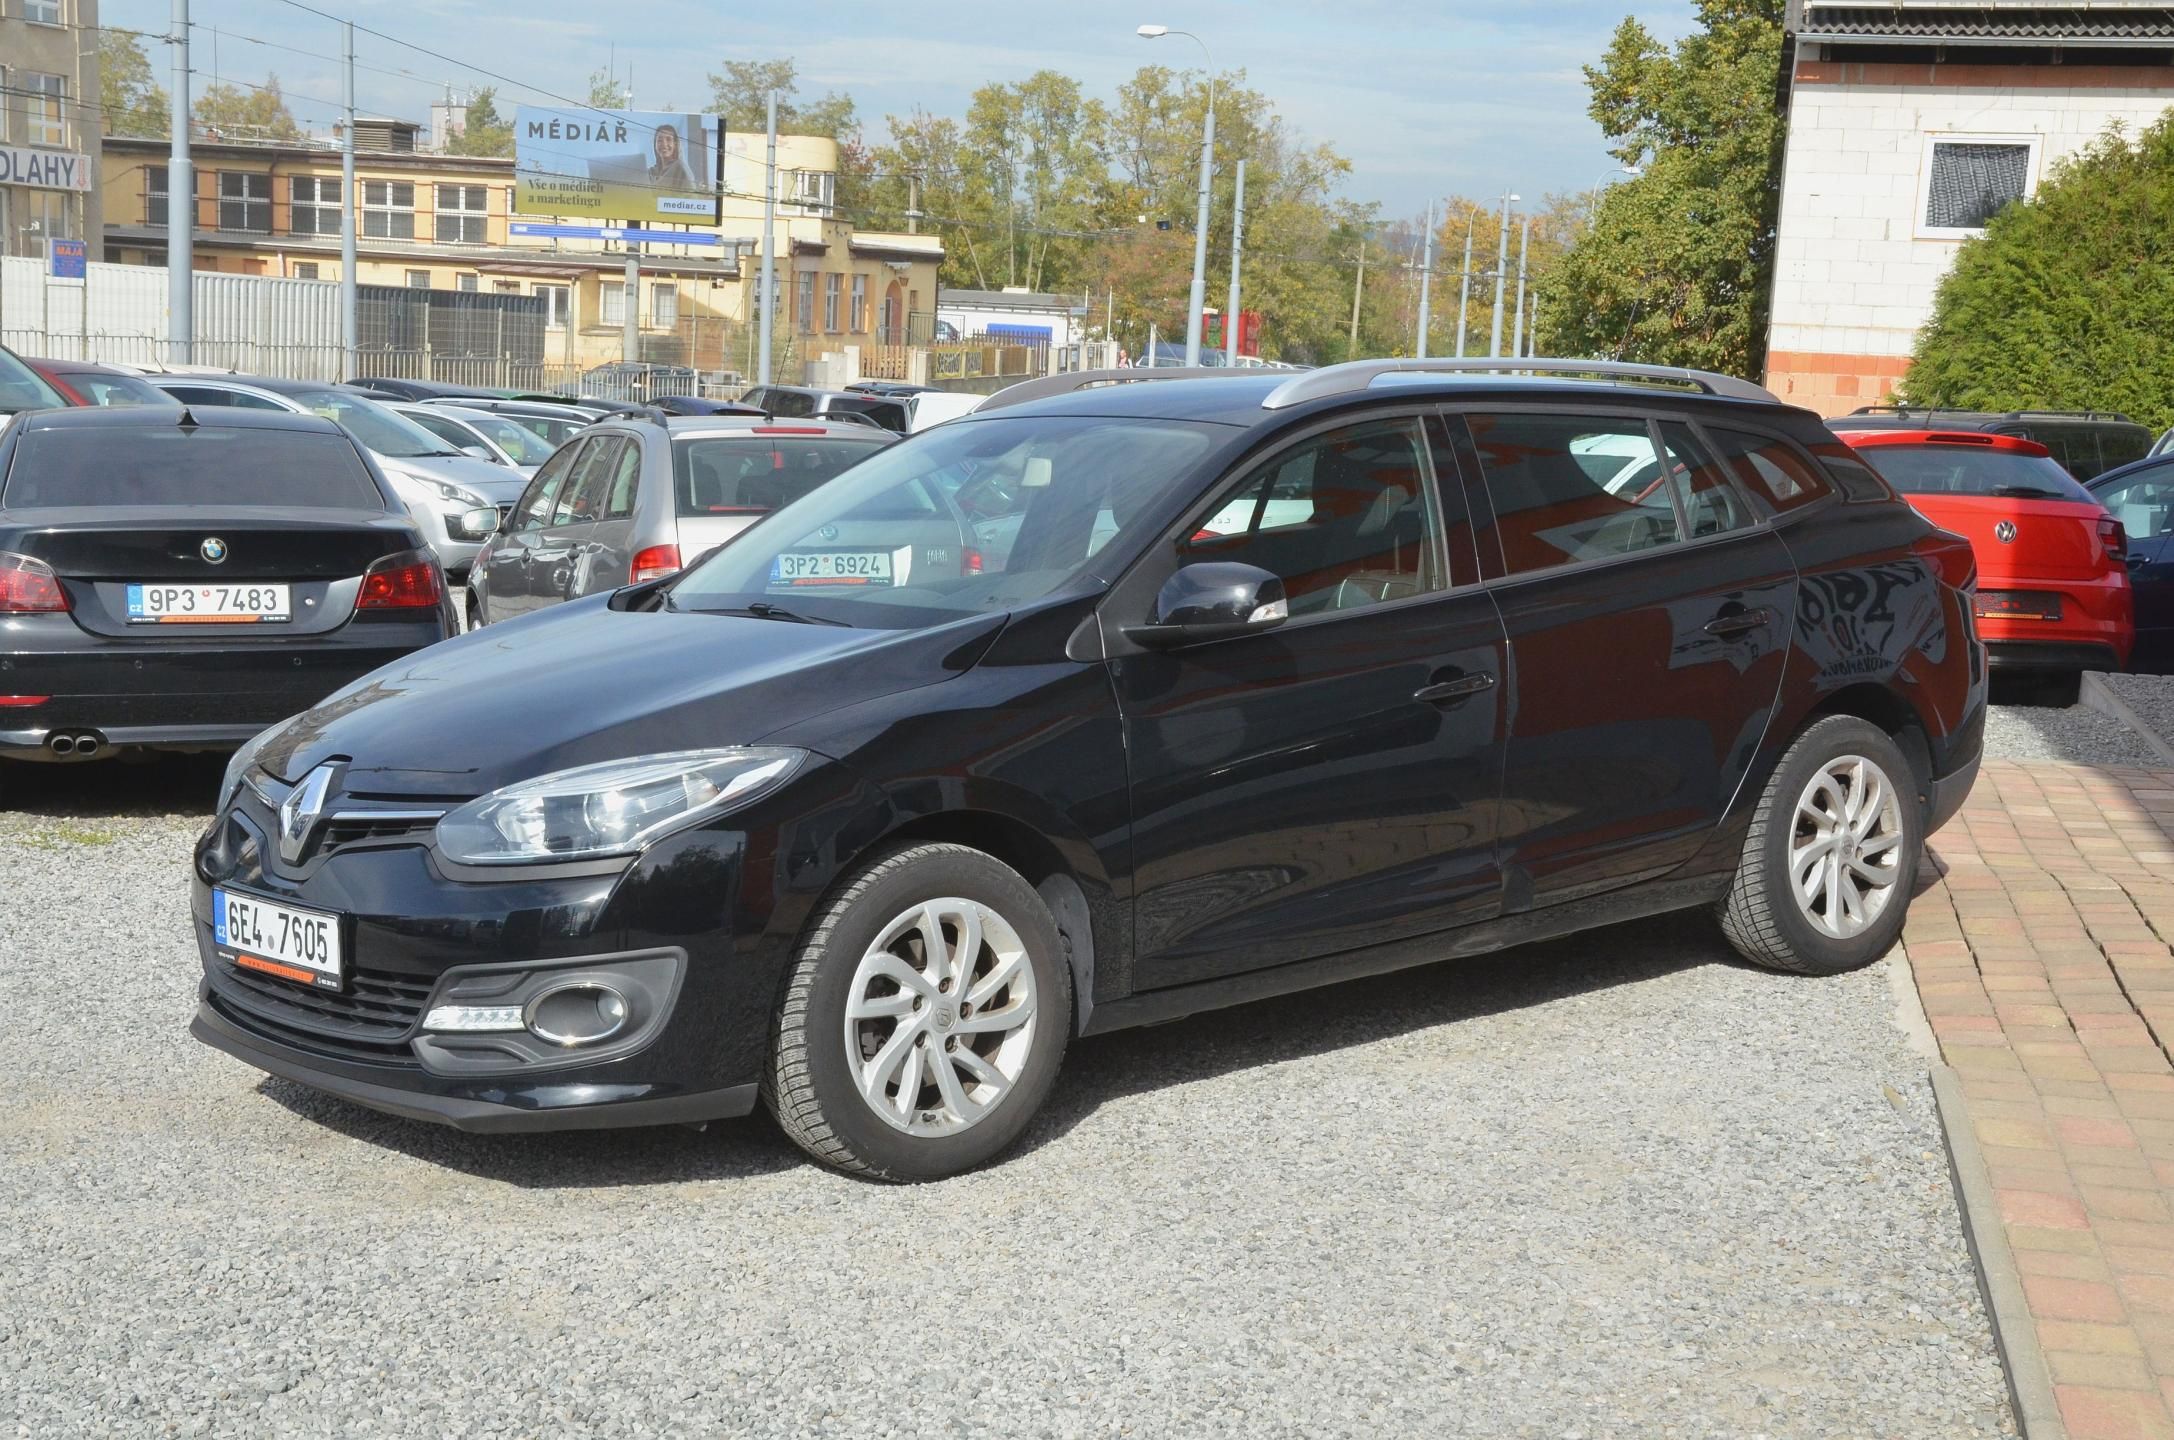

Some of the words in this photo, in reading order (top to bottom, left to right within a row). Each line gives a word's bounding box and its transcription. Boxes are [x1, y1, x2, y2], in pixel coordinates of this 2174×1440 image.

[528, 118, 628, 144] MÉDIÁŘ
[528, 178, 547, 190] Vše
[527, 194, 535, 203] a
[537, 194, 601, 208] marketingu
[663, 201, 707, 211] mediar.cz
[784, 557, 819, 575] 3P2
[834, 557, 880, 575] 6924
[149, 589, 195, 612] 9P3
[216, 588, 277, 612] 7483
[129, 604, 142, 612] CZ
[216, 925, 226, 938] CZ
[229, 901, 262, 949] 6E4
[278, 912, 328, 964] 7605
